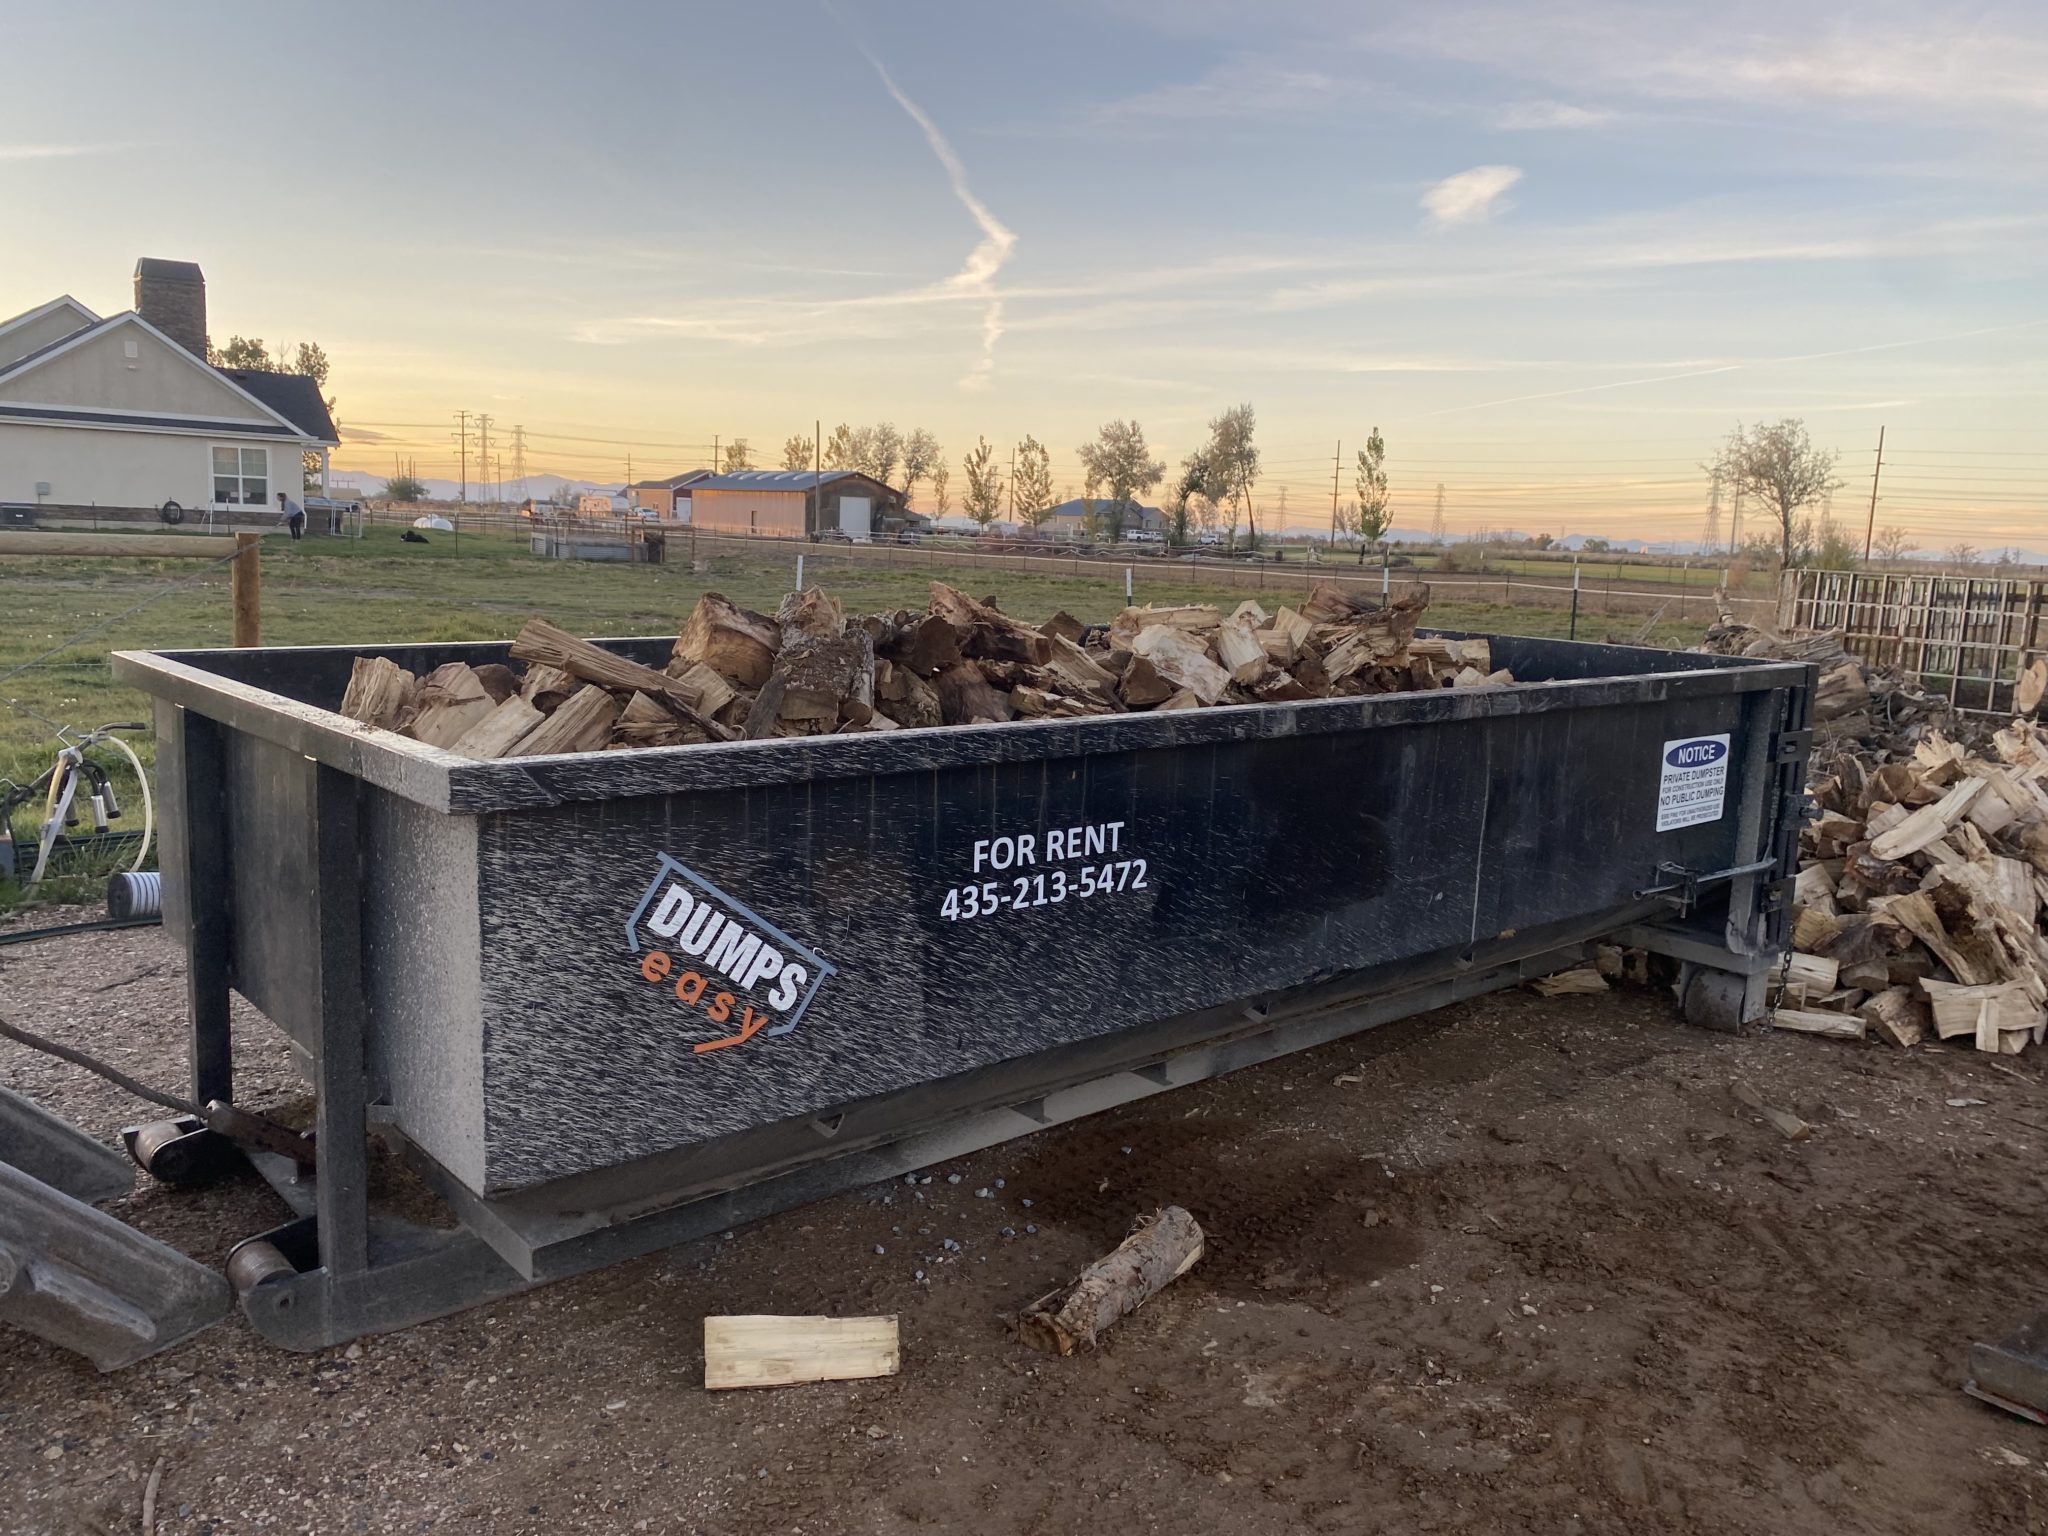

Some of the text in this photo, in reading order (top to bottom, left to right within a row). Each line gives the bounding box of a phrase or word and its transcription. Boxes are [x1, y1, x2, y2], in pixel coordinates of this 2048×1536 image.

[1678, 744, 1716, 764] NOTICE
[1662, 786, 1671, 794] FOR
[1673, 781, 1704, 793] CONSTRUCTION
[1713, 777, 1724, 786] ONLY
[1663, 766, 1725, 785] PRIVATE DUMPSTER
[1660, 785, 1724, 806] NO PUBLIC DUMPING
[973, 821, 1125, 873] FOR RENT
[940, 859, 1148, 921] 435-213-5472
[646, 882, 808, 1011] DUMPS
[641, 950, 769, 1054] easy
